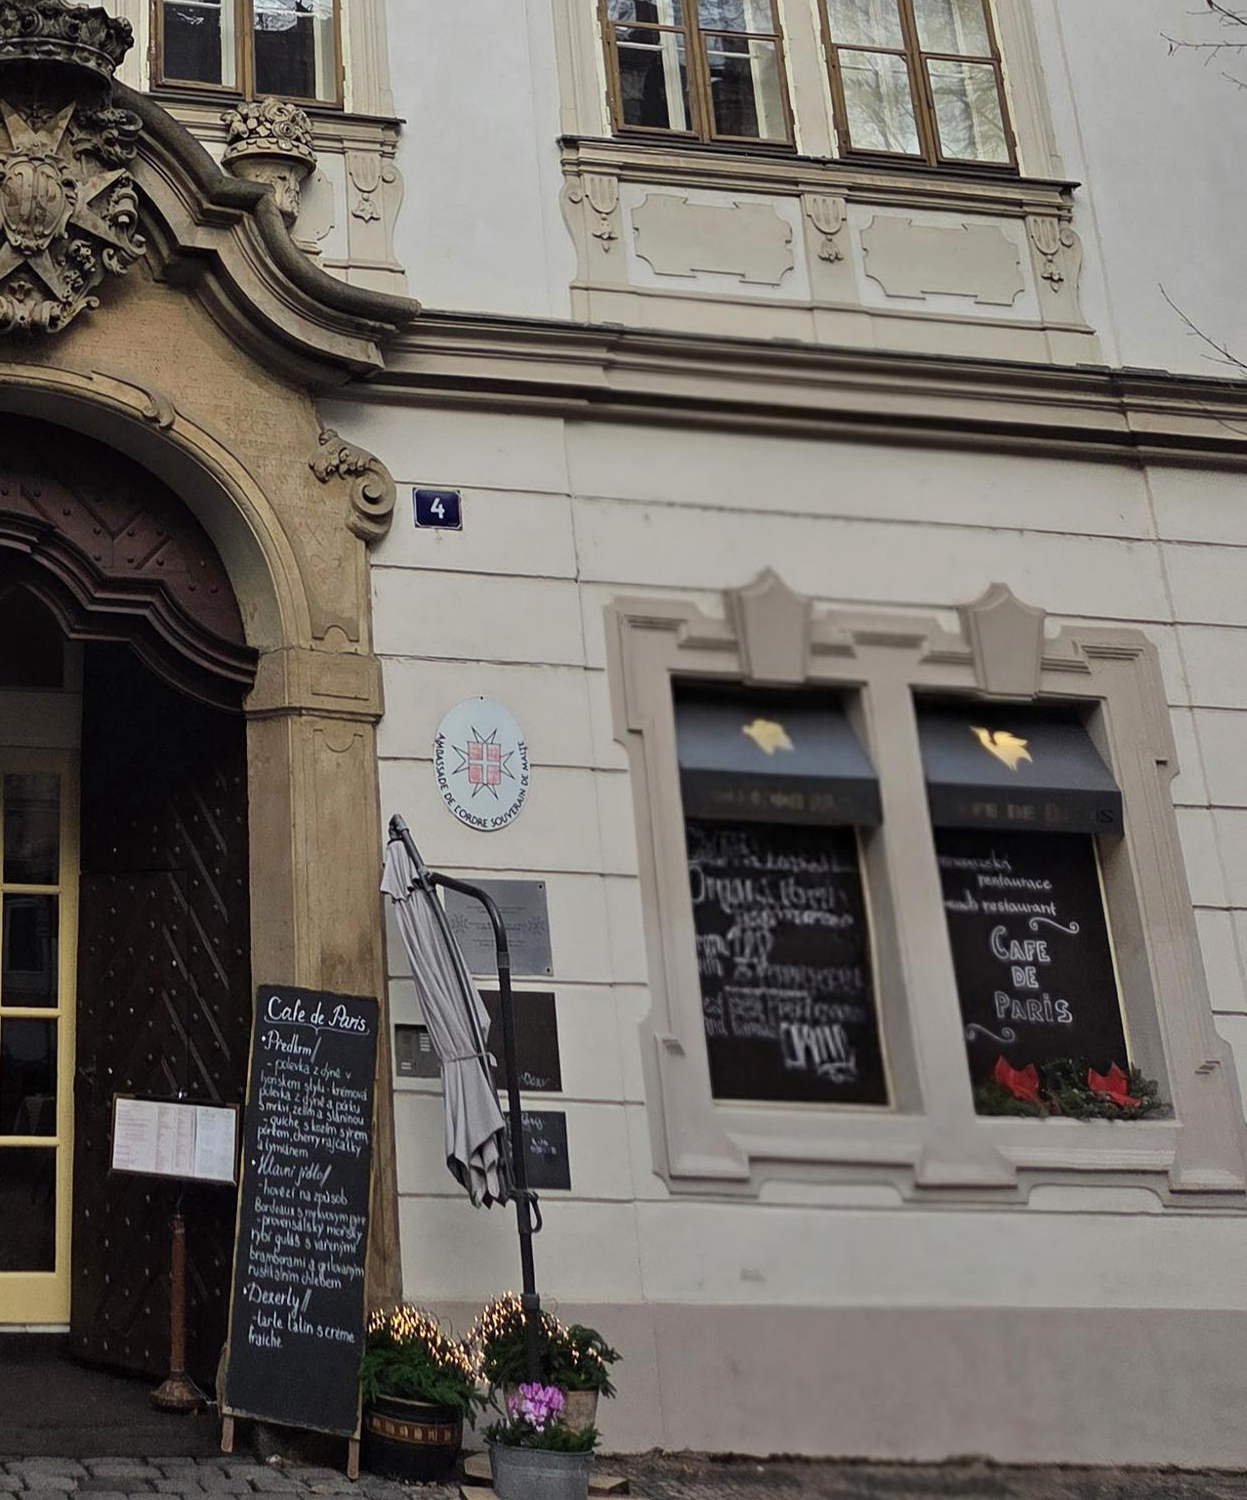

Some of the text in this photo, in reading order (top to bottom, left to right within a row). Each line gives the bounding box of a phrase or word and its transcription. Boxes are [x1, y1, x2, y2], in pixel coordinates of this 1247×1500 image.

[430, 497, 445, 519] 4
[434, 732, 449, 792] AMBASSADE
[517, 740, 529, 772] MALTE
[520, 773, 529, 787] DE
[443, 792, 456, 806] DE
[491, 788, 526, 828] SOUVERAIN
[982, 898, 1057, 916] restaurant
[1011, 966, 1039, 988] DE
[310, 1001, 325, 1025] de
[328, 1004, 367, 1032] Paris
[299, 1190, 312, 1202] na
